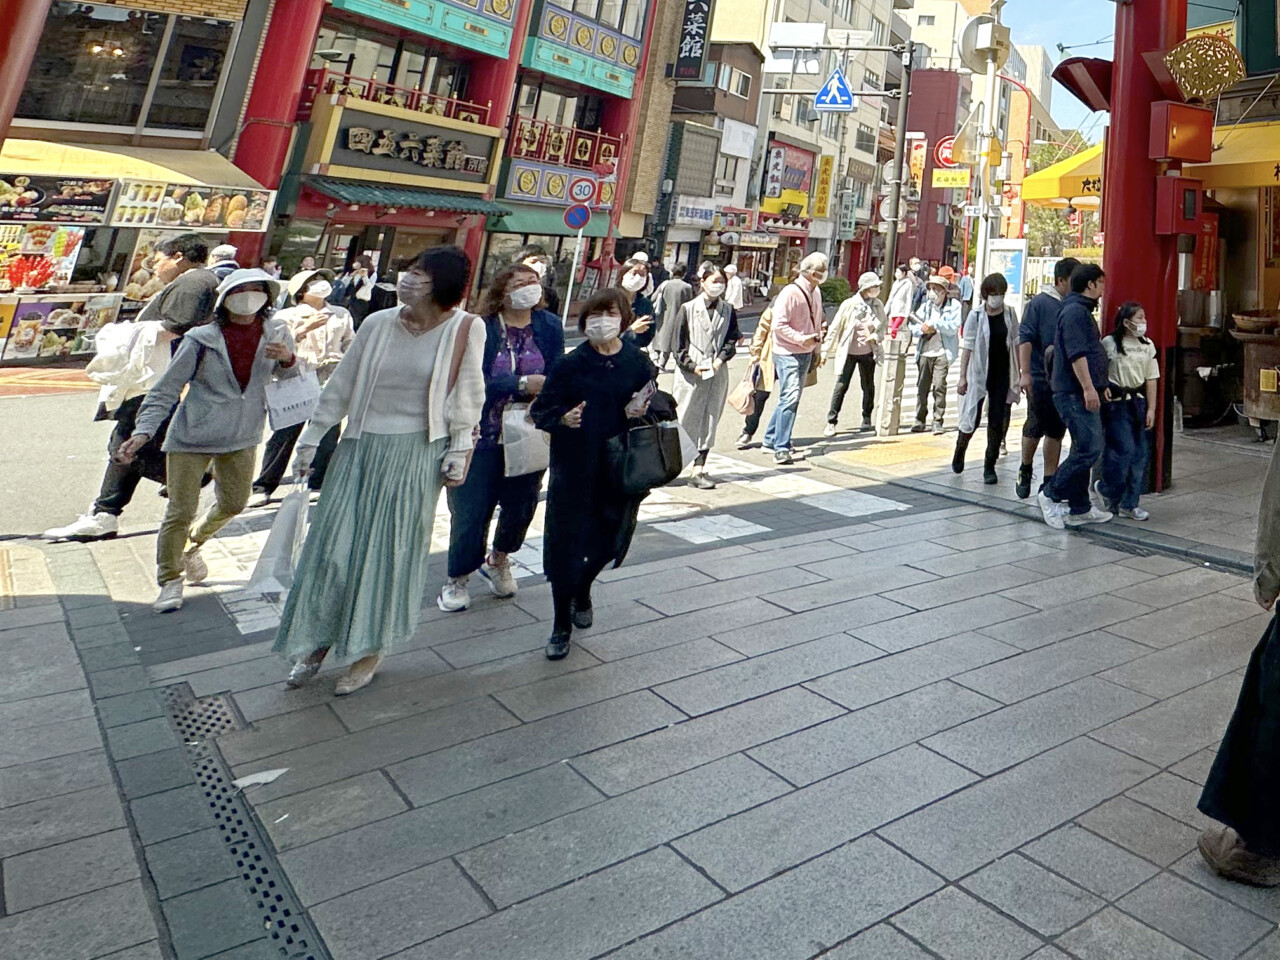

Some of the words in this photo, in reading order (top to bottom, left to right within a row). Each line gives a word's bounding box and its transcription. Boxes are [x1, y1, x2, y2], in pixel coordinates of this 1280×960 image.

[347, 126, 468, 171] 四五六菜館
[574, 184, 592, 197] 30
